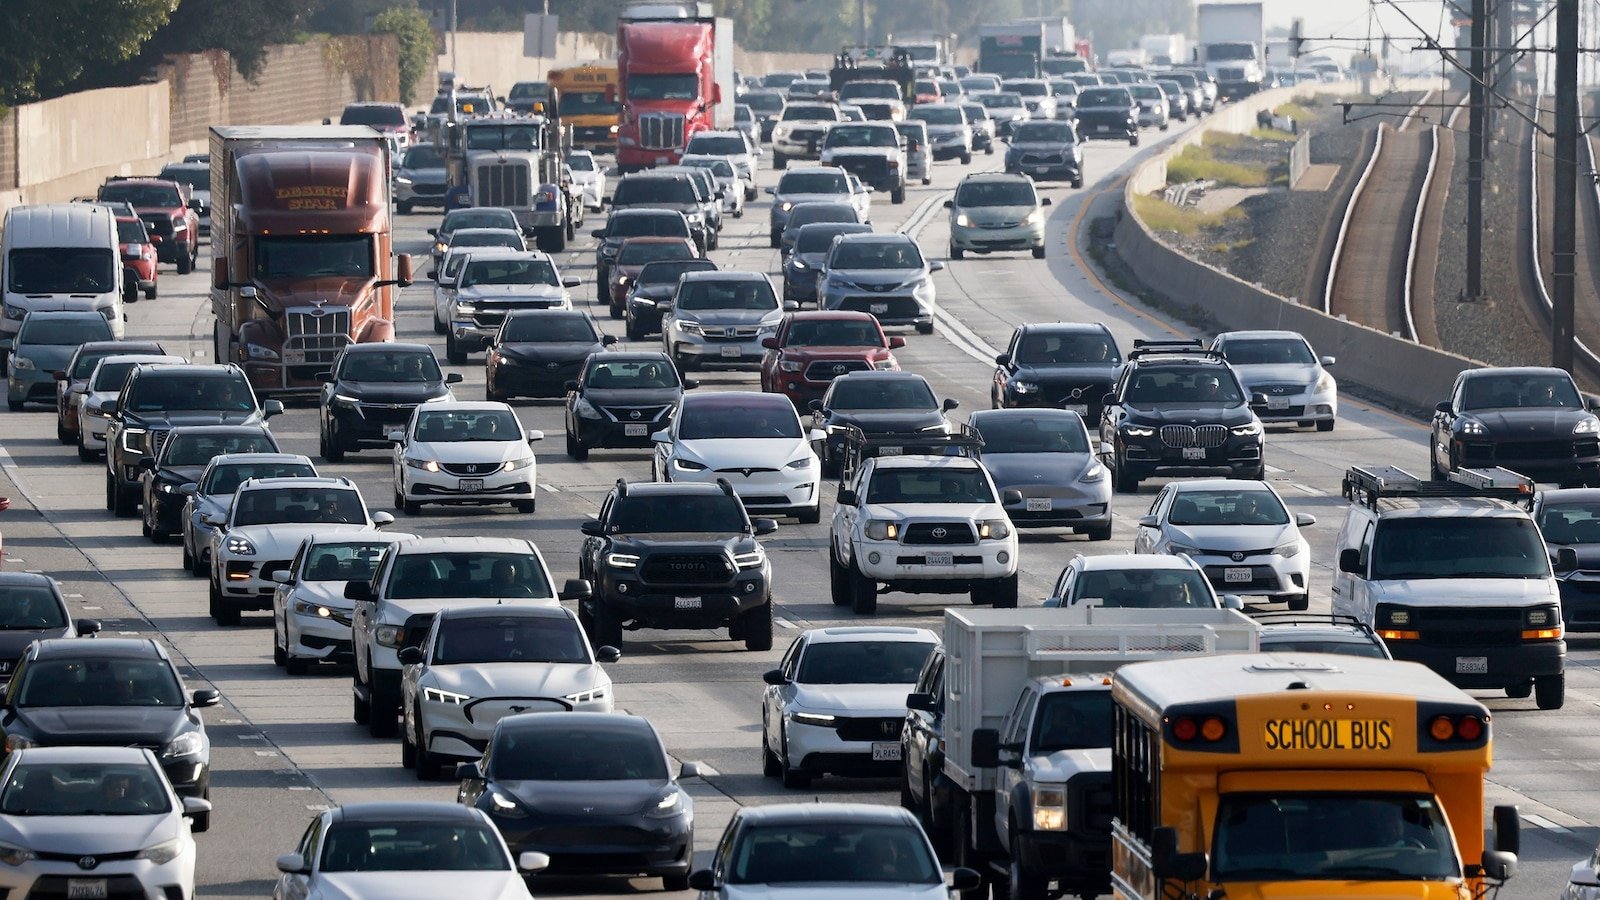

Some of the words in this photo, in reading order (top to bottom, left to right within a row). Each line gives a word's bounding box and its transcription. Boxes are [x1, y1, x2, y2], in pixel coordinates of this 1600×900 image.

[275, 186, 347, 199] DESERT
[288, 199, 337, 210] STAR
[1265, 719, 1345, 750] SCHOOL
[1351, 720, 1391, 750] BUS
